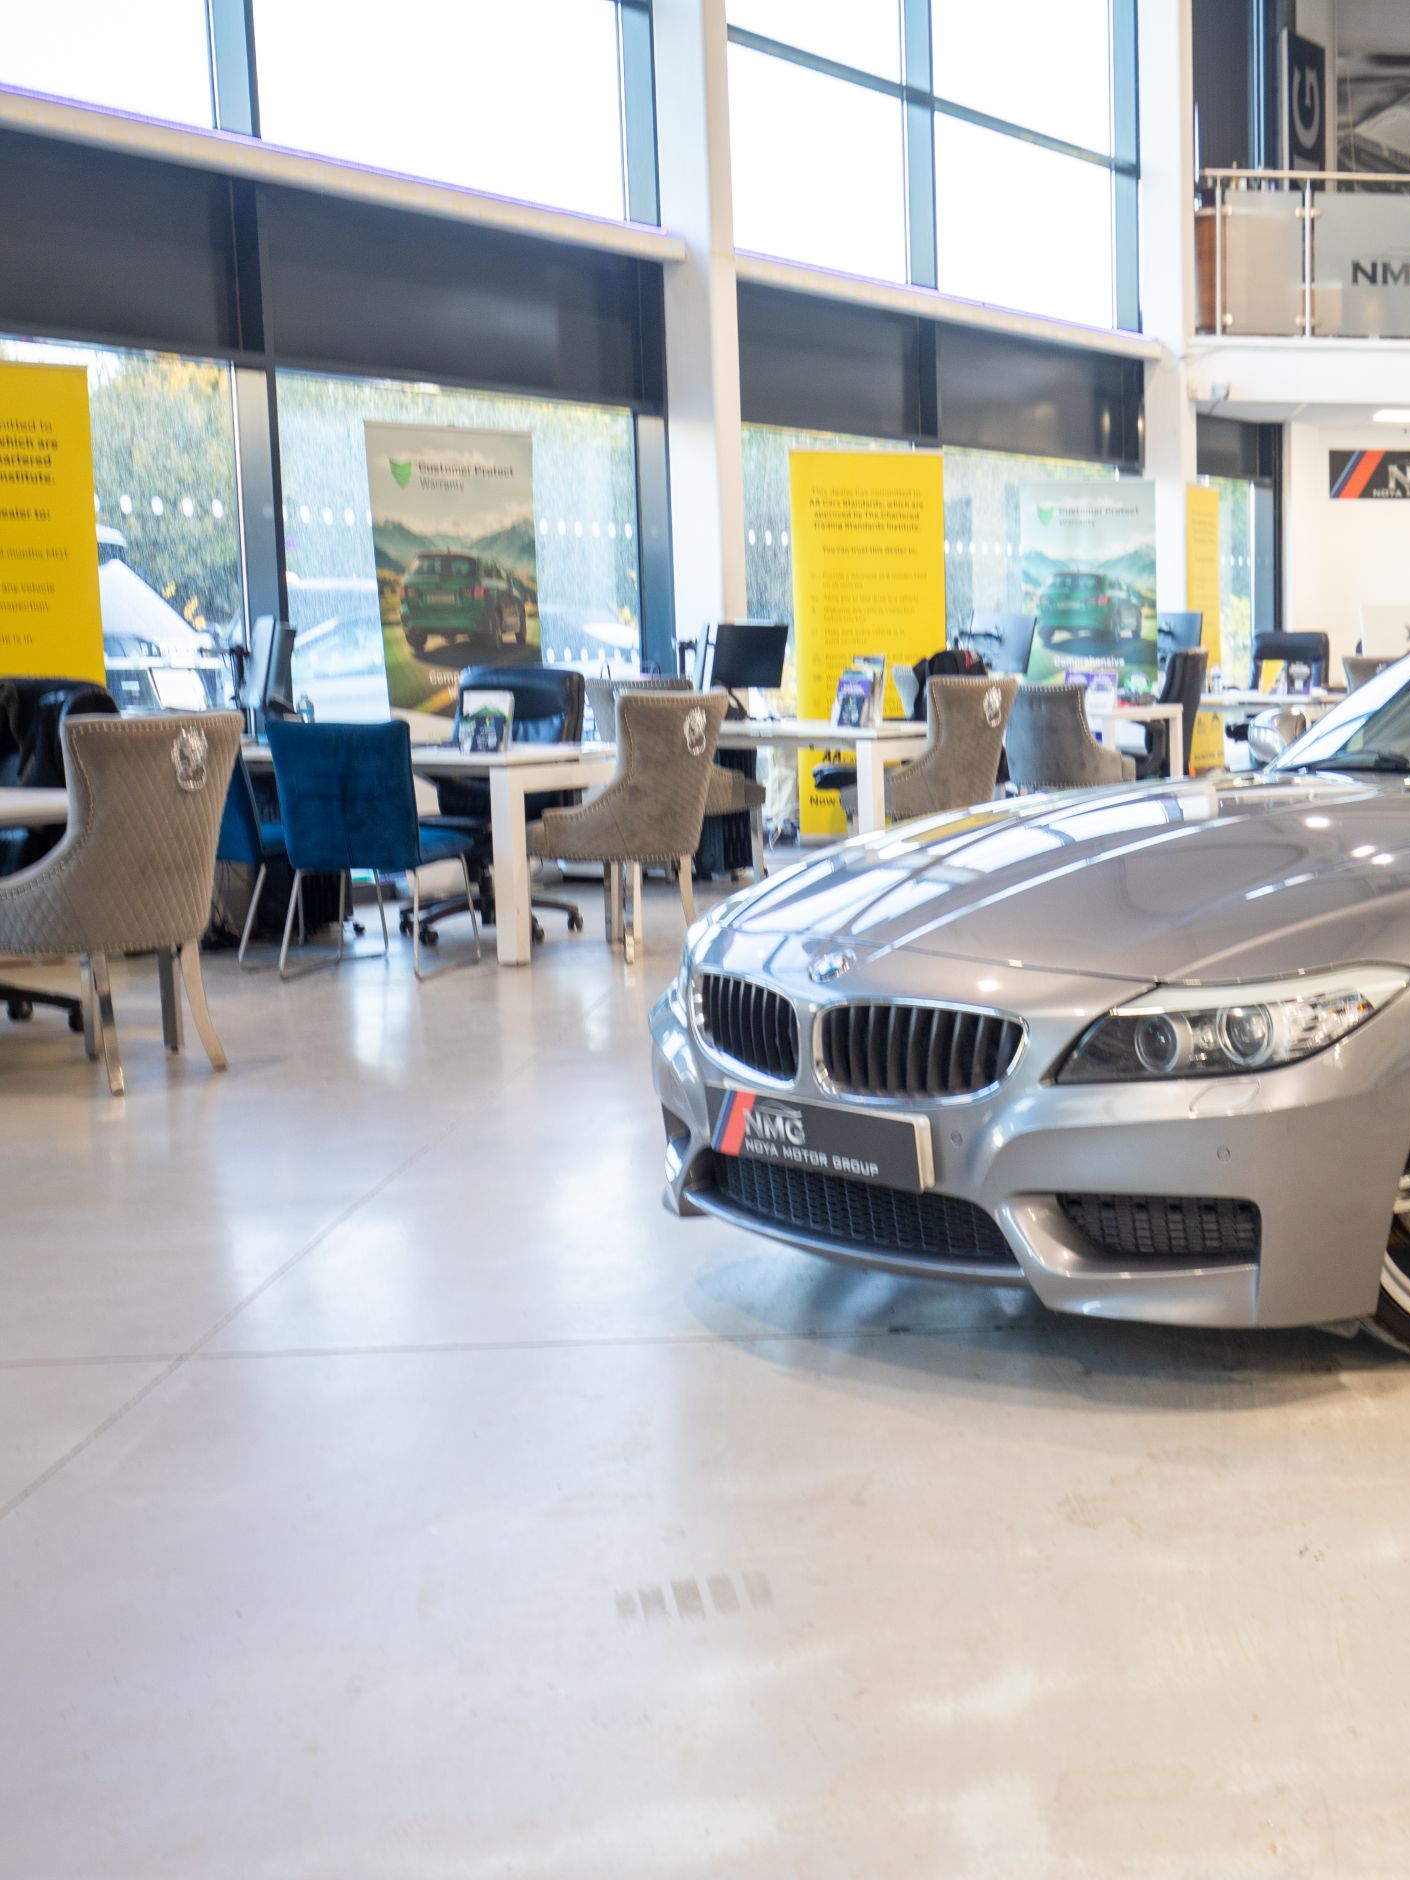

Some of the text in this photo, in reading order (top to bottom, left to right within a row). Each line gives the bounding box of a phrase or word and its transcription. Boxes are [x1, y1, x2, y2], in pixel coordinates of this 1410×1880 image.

[420, 477, 464, 492] Warranty
[1373, 489, 1402, 498] NOYA
[743, 1107, 806, 1146] NMG
[745, 1137, 880, 1177] NOYA MOTOR GROUP
